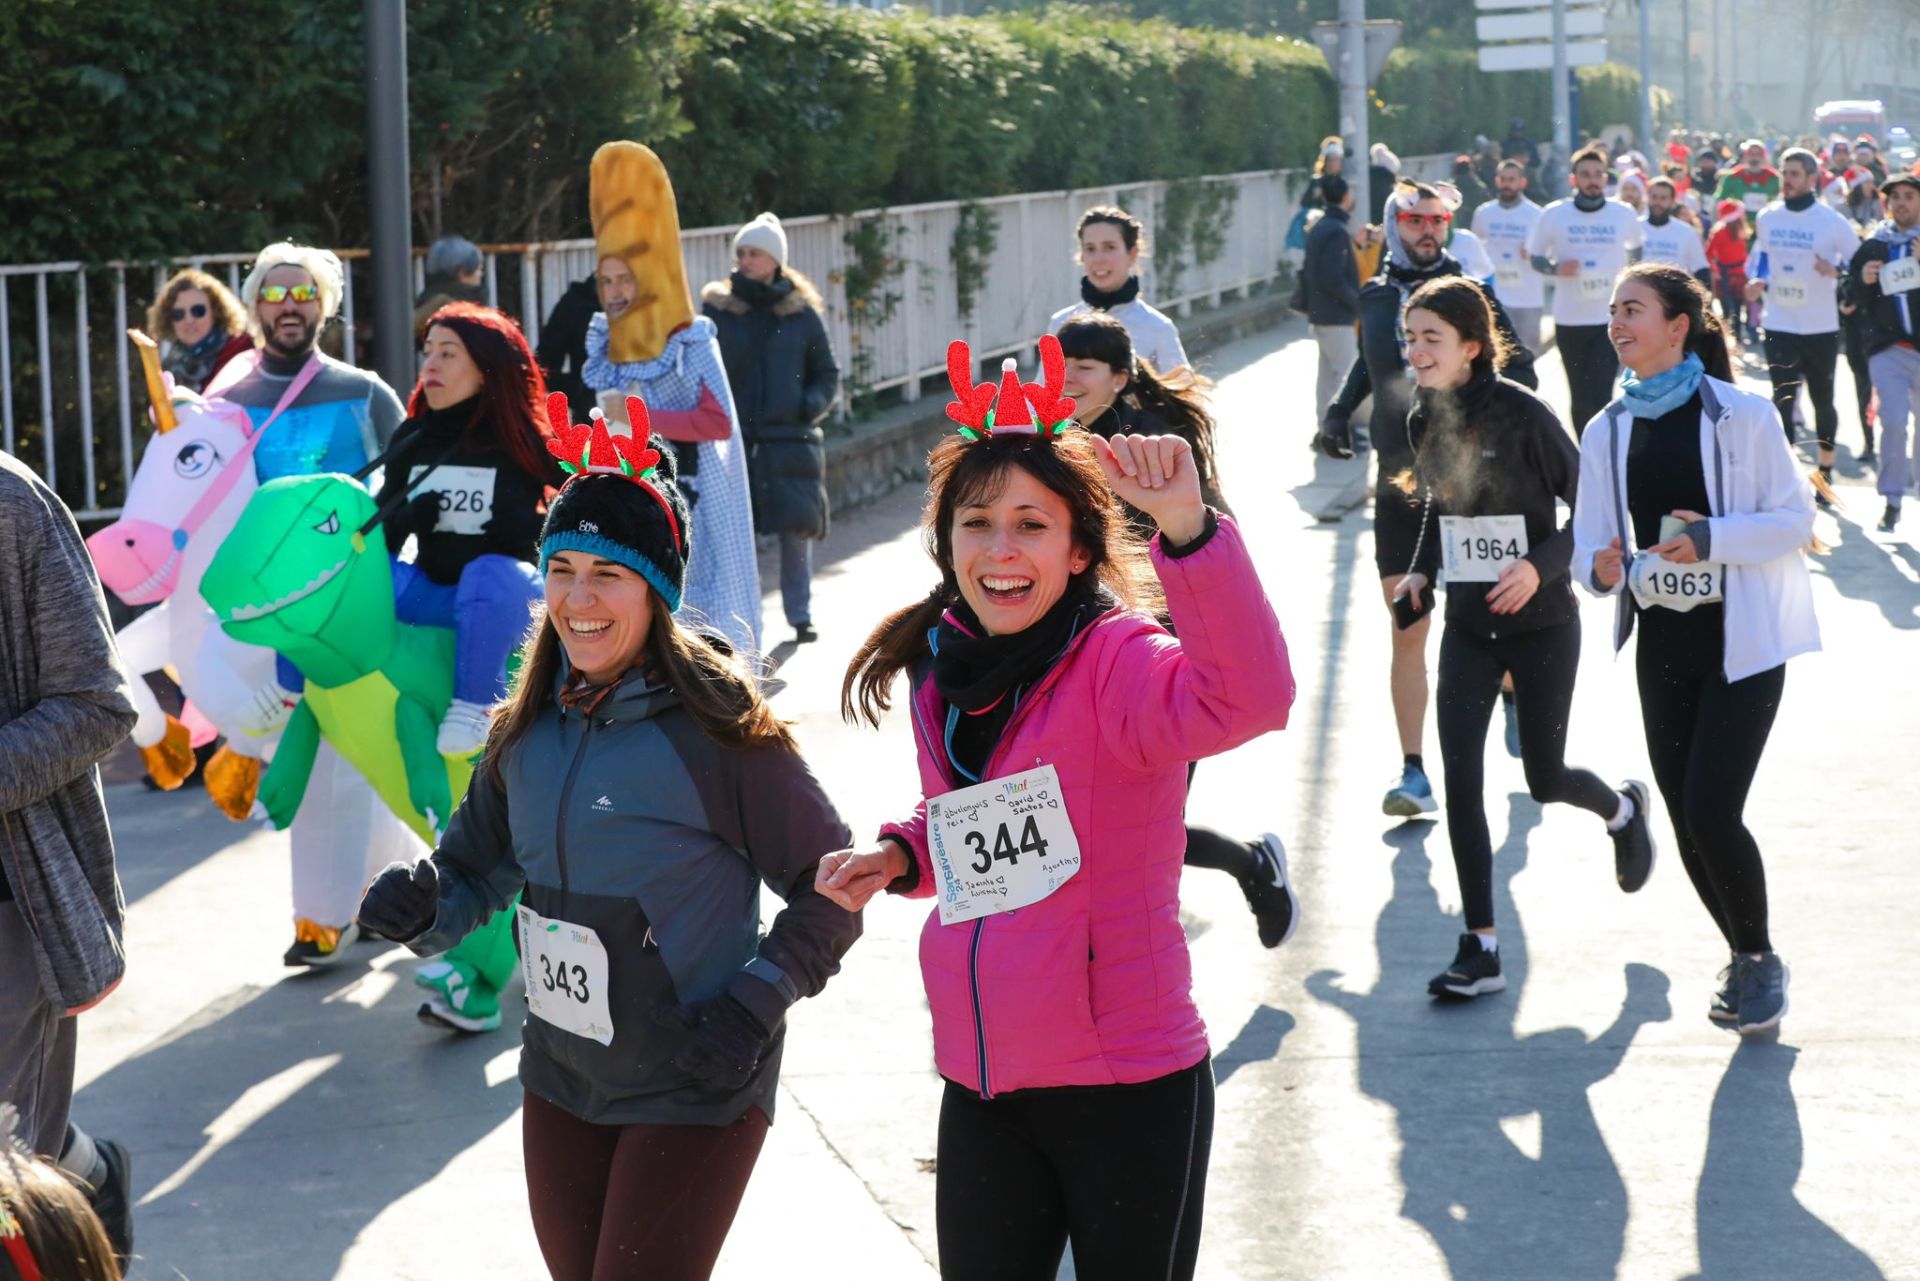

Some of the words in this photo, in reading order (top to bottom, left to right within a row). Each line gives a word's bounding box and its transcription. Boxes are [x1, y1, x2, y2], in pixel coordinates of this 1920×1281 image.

[1893, 269, 1914, 282] 349
[1461, 537, 1521, 562] 1964
[1647, 571, 1713, 597] 1963
[1002, 778, 1028, 795] Vital
[1008, 794, 1035, 808] David
[965, 814, 1049, 875] 344
[540, 953, 590, 1005] 343
